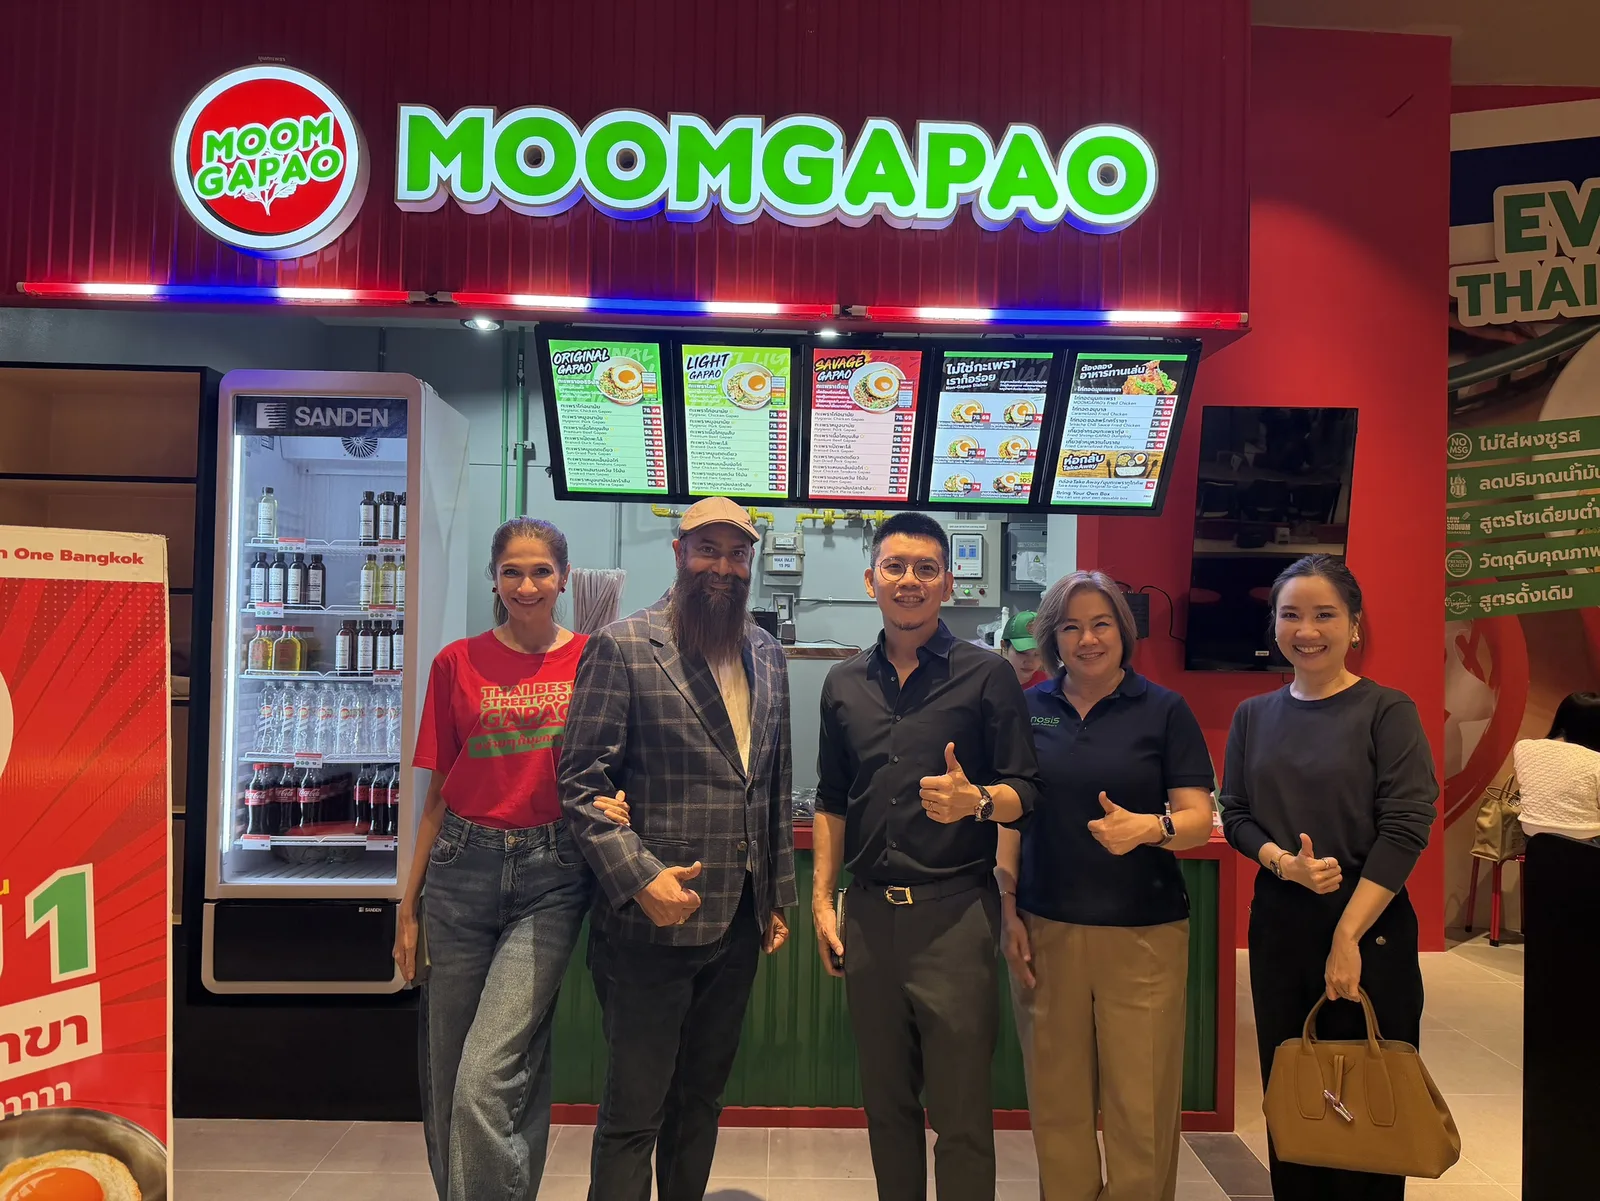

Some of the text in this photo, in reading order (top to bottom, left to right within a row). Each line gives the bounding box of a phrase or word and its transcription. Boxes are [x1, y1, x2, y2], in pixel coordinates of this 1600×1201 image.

[204, 113, 336, 164] MOOM
[195, 147, 343, 198] GAPAO
[401, 109, 1153, 221] MOOMGAPAO
[1455, 263, 1598, 317] THAI
[552, 349, 609, 366] ORIGINAL
[686, 353, 731, 371] LIGHT
[815, 355, 865, 372] SAVAGE
[557, 362, 593, 375] GAPAO
[689, 369, 723, 380] GAPAO
[817, 369, 852, 381] GAPAO
[946, 359, 1017, 375] ไม่ใช่กะเพรา
[1079, 364, 1146, 380] อาหารทานเล่น
[946, 373, 996, 386] เราก็อร่อย
[295, 406, 389, 428] SANDEN
[1451, 437, 1467, 446] NO
[1479, 430, 1580, 451] ไม่ใส่ผงชูรส
[1450, 446, 1469, 454] MSG
[1447, 523, 1471, 531] SODIUM
[14, 547, 54, 561] One
[60, 549, 144, 566] Bangkok
[1479, 582, 1574, 612] สูตรดั้งเดิม
[481, 684, 531, 699] THAI
